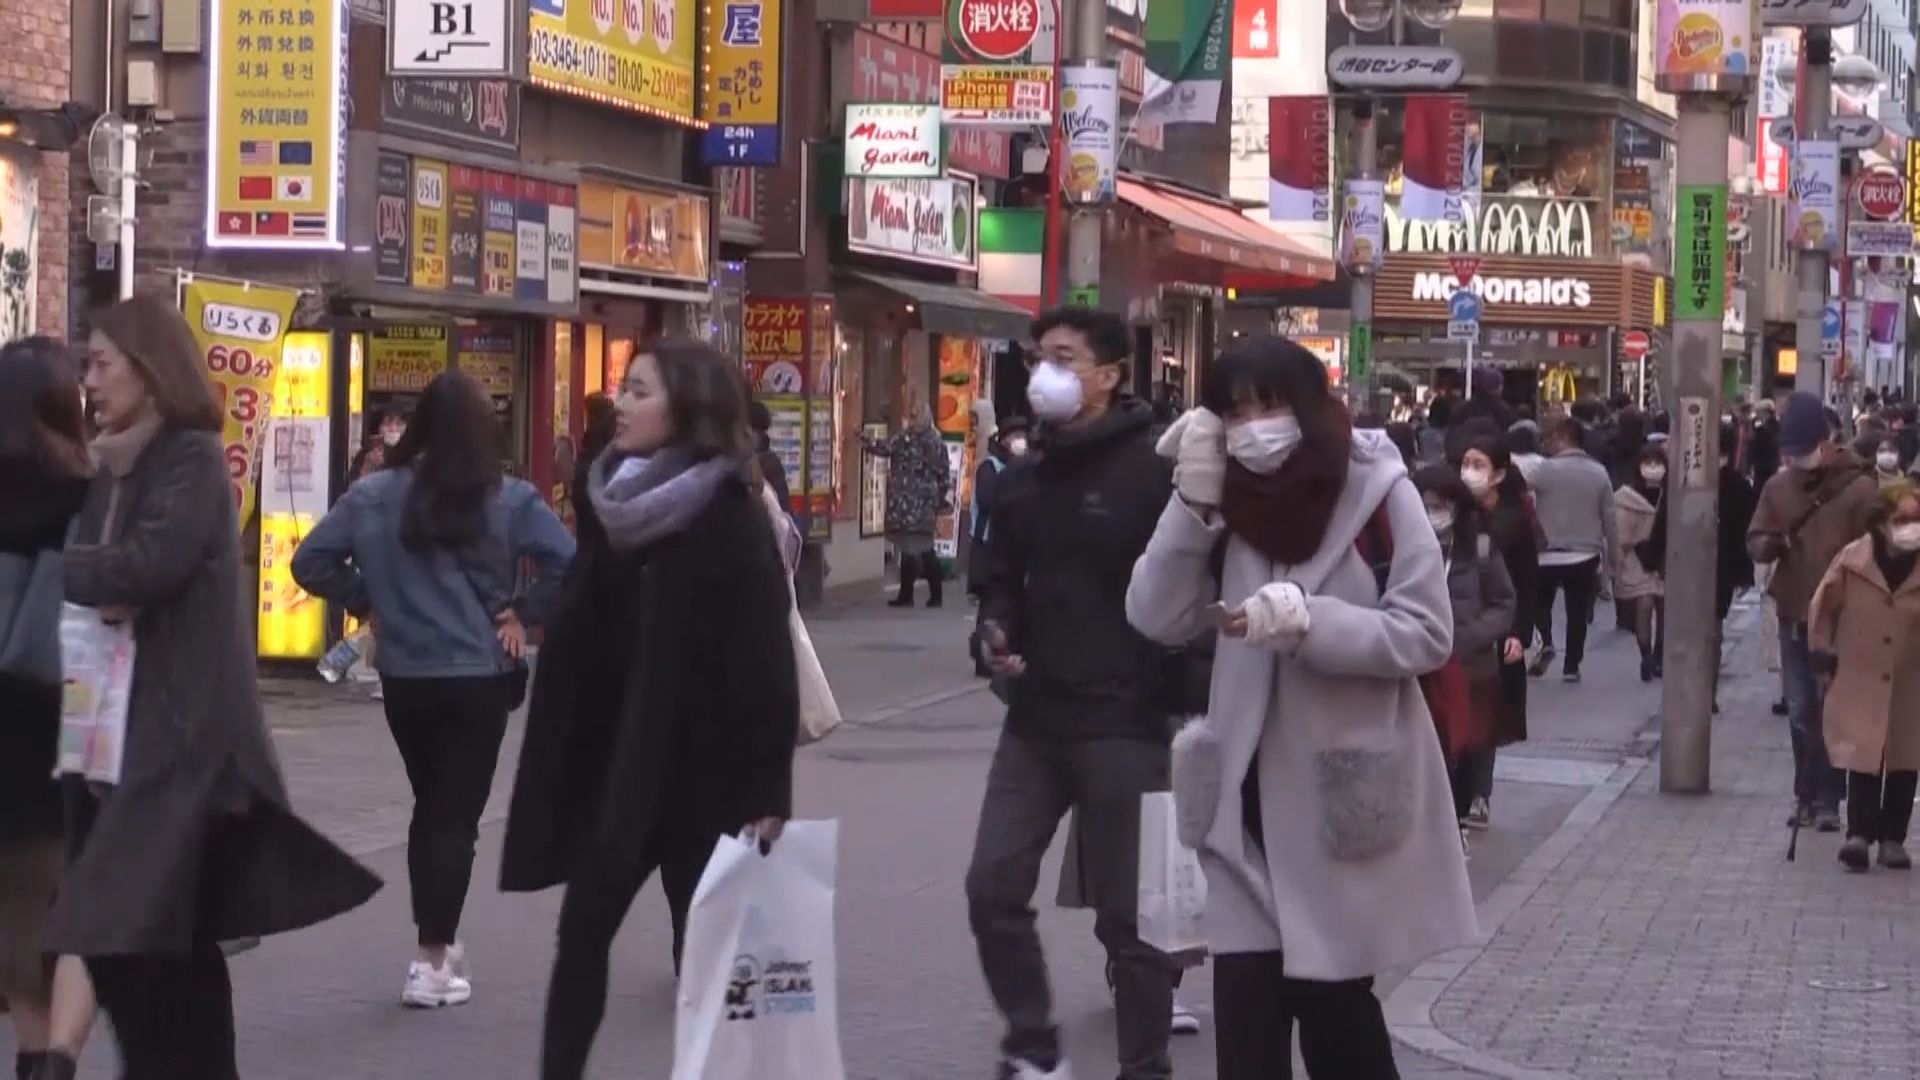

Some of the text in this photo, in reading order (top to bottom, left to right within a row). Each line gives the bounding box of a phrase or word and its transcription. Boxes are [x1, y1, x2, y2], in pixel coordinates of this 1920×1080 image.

[430, 2, 476, 35] B1
[622, 0, 645, 33] No.1
[651, 4, 674, 41] No.1
[721, 3, 763, 45] 屋
[968, 2, 1033, 33] 消火栓
[733, 67, 747, 111] カレー
[724, 126, 755, 139] 24h
[870, 183, 909, 233] Miami
[1312, 171, 1330, 221] 2020
[1443, 171, 1463, 221] 2020
[1412, 271, 1591, 308] McDonald's
[208, 308, 272, 336] りらくる
[744, 303, 805, 328] カラオケ
[207, 345, 274, 379] 60分
